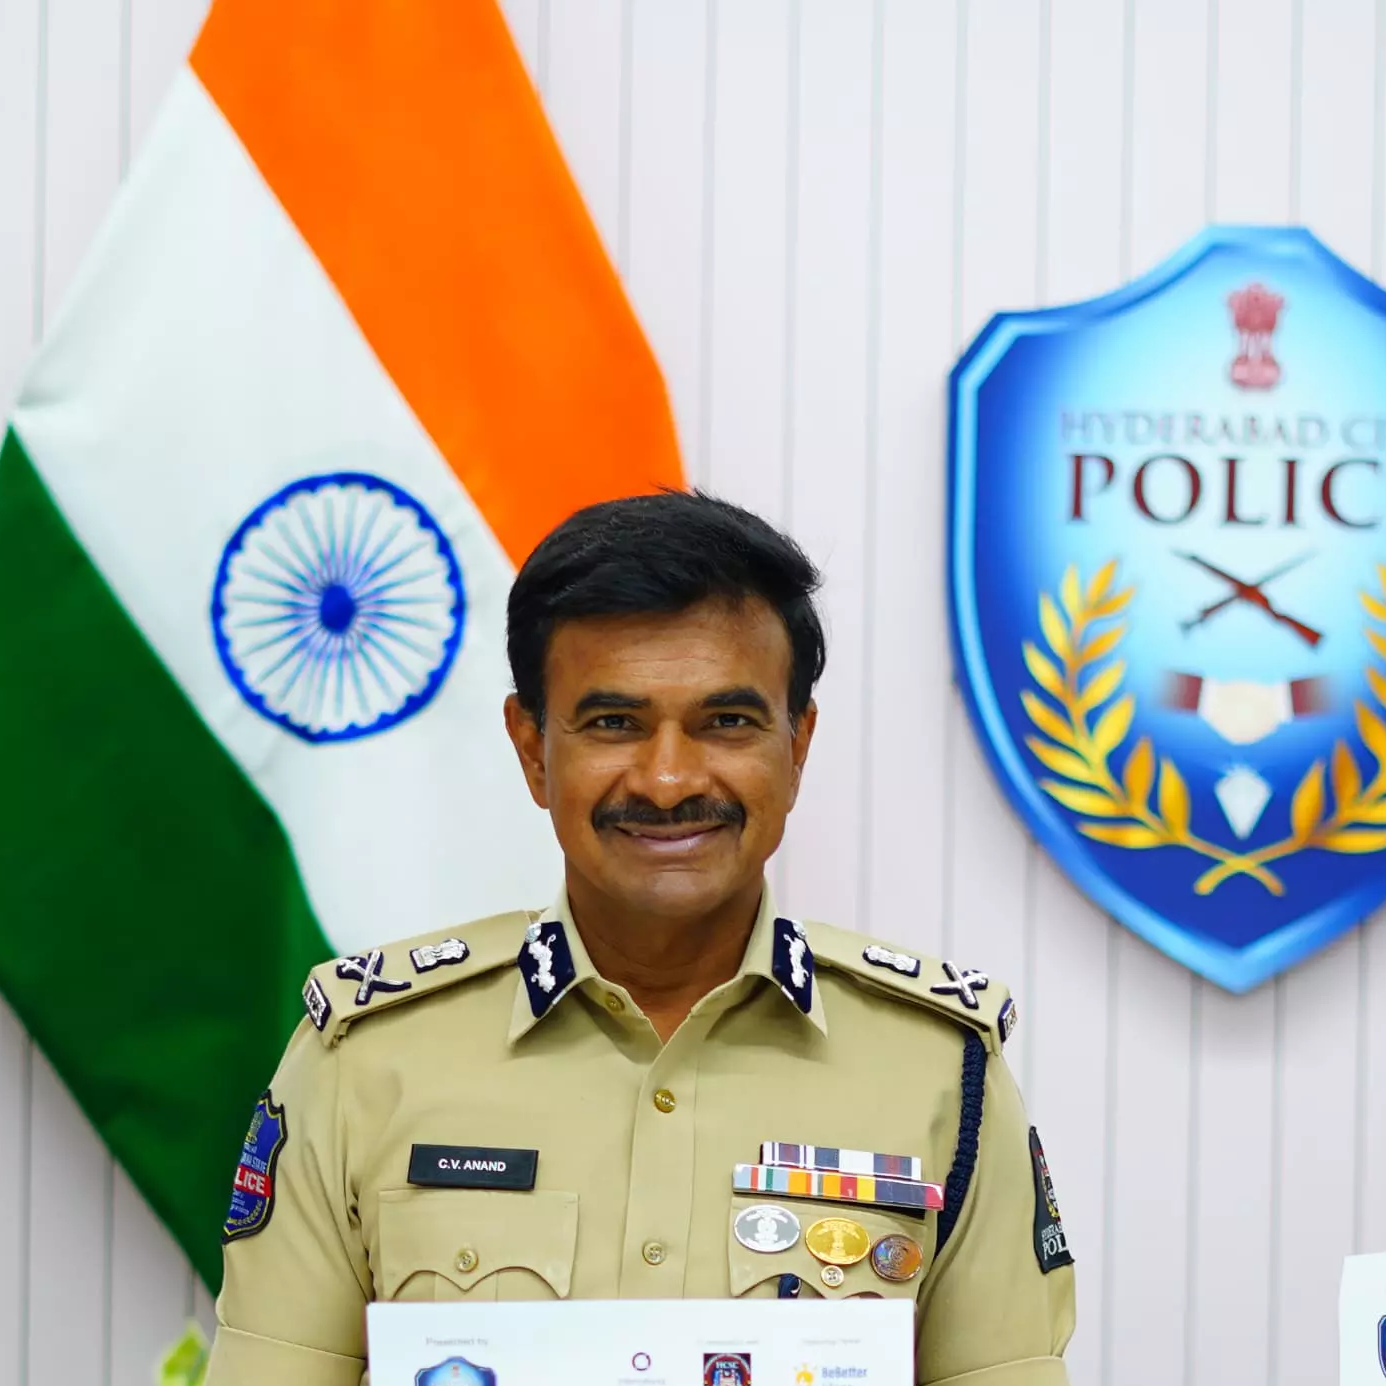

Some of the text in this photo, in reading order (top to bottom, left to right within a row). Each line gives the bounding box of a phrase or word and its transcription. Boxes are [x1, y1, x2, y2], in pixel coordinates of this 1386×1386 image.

[1060, 411, 1330, 447] HYDERABAD
[438, 1159, 506, 1172] C.V. ANAND
[234, 1167, 265, 1194] LICE
[1043, 1234, 1068, 1260] POL
